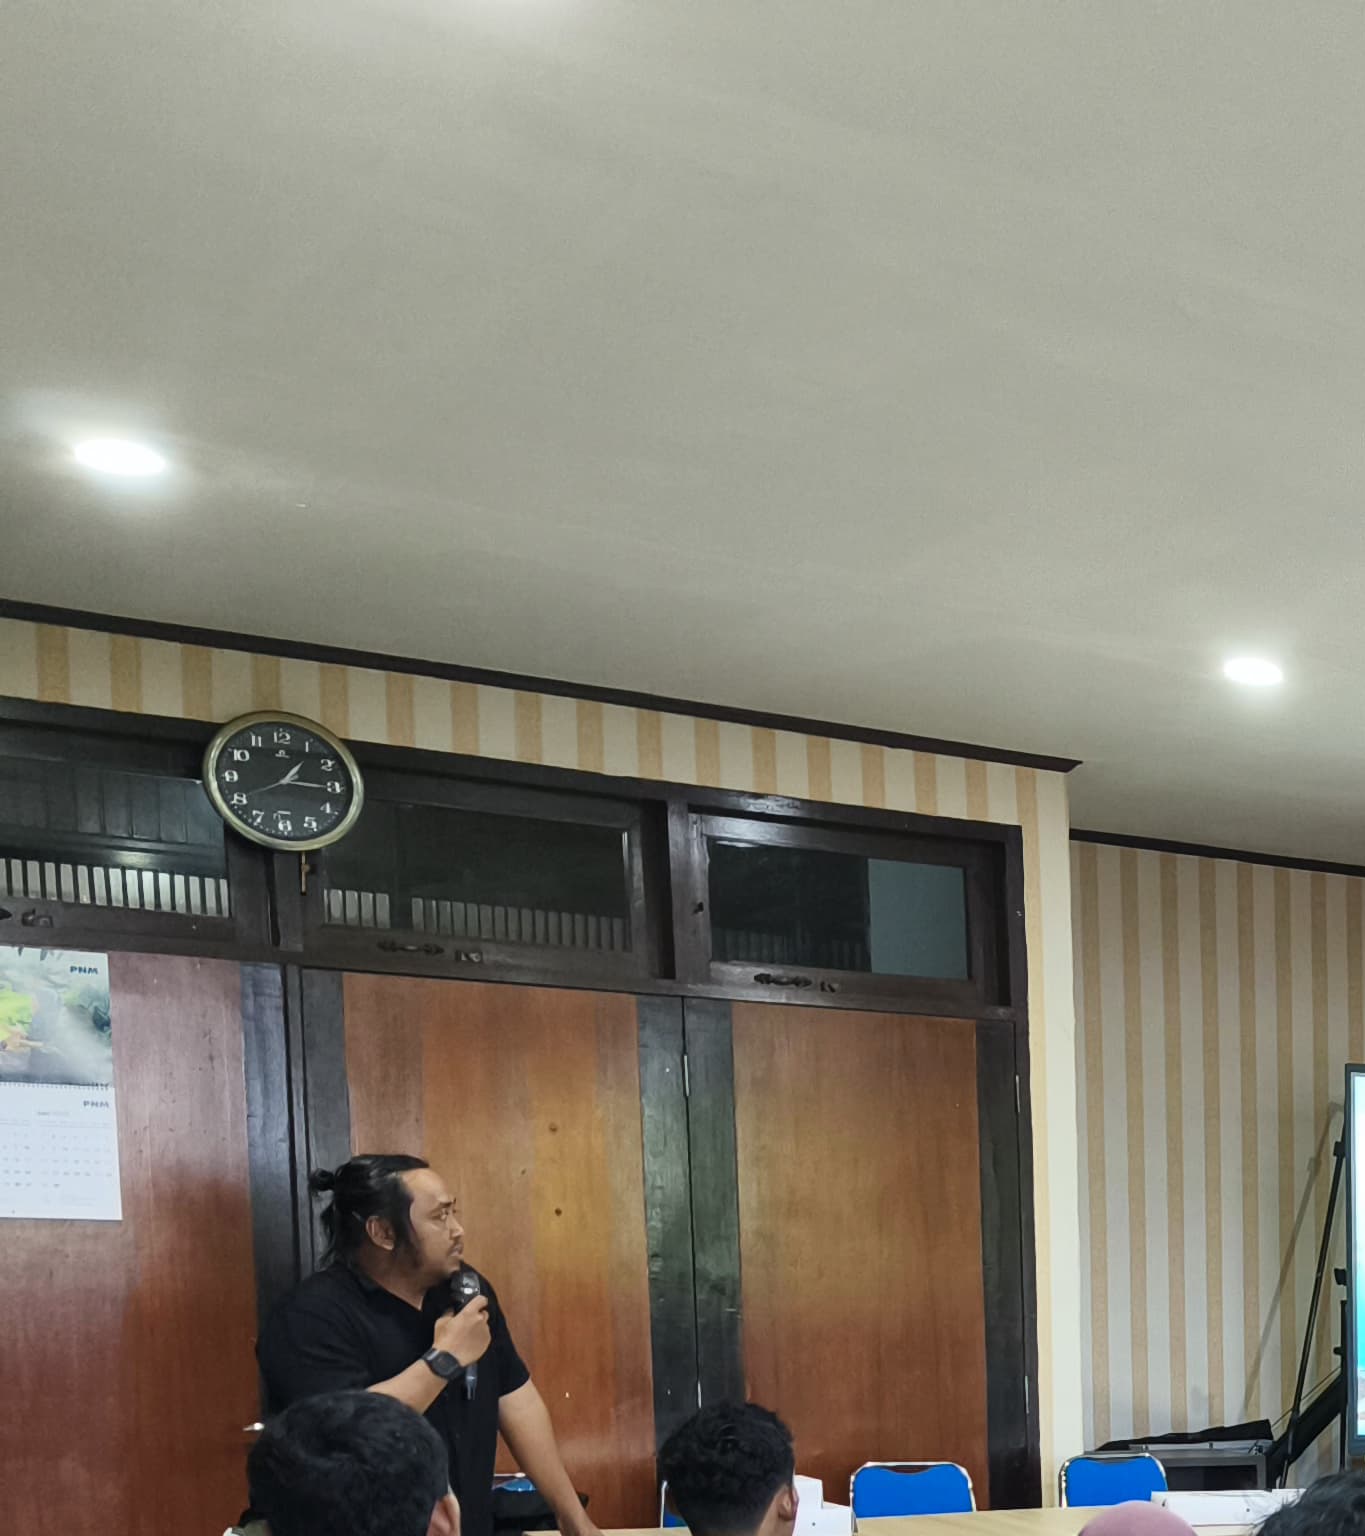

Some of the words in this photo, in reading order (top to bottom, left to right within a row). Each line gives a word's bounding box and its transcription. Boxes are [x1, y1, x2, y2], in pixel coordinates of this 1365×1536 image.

[251, 735, 262, 747] 11
[274, 731, 291, 744] 12
[233, 749, 250, 761] 10
[320, 759, 335, 771] 2
[224, 770, 239, 782] 9
[232, 792, 248, 805] 8
[320, 802, 331, 814] 4
[252, 810, 265, 825] 7
[303, 816, 318, 829] 5
[69, 965, 99, 975] PNM
